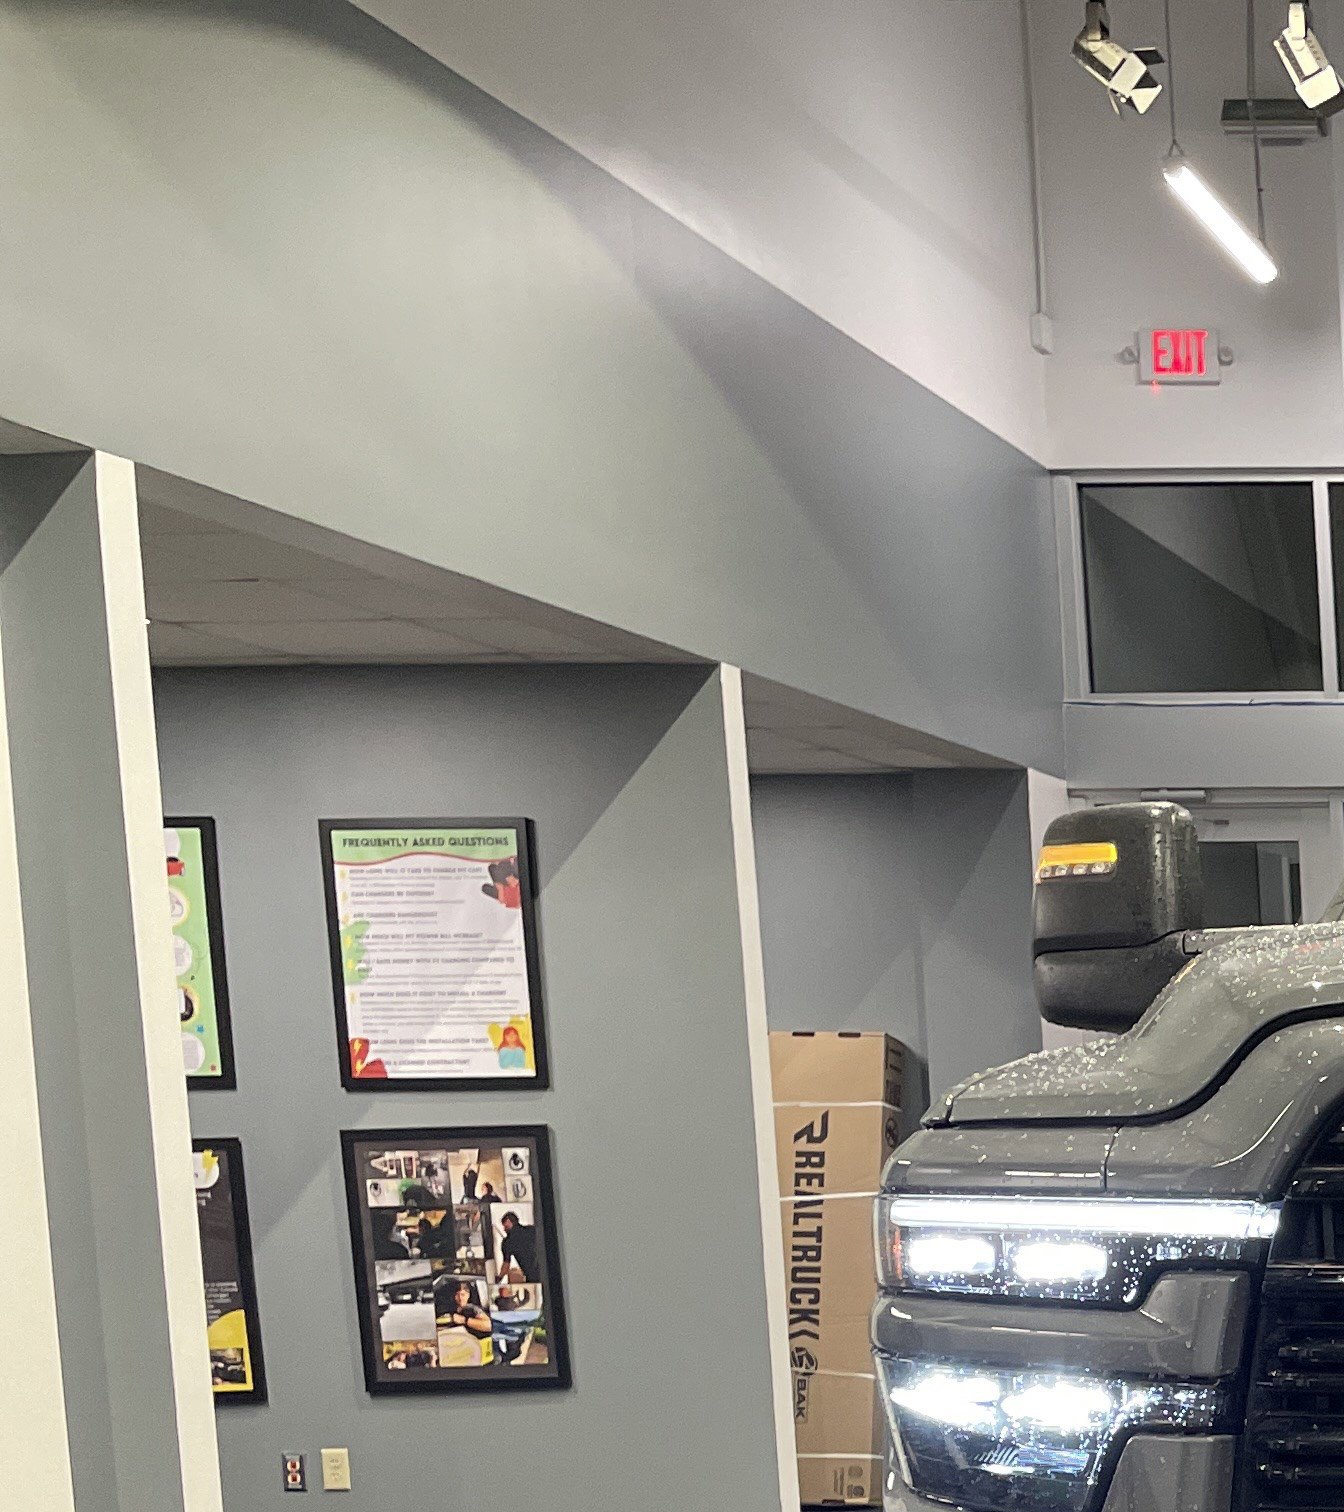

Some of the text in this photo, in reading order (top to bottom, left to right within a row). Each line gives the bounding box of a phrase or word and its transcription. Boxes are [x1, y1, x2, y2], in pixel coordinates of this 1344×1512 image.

[1152, 329, 1208, 375] EXIT
[342, 836, 510, 848] FREQUENTLY ASKED QUESTIONS
[788, 1150, 825, 1327] REALTRUCK
[795, 1378, 807, 1418] BAK
